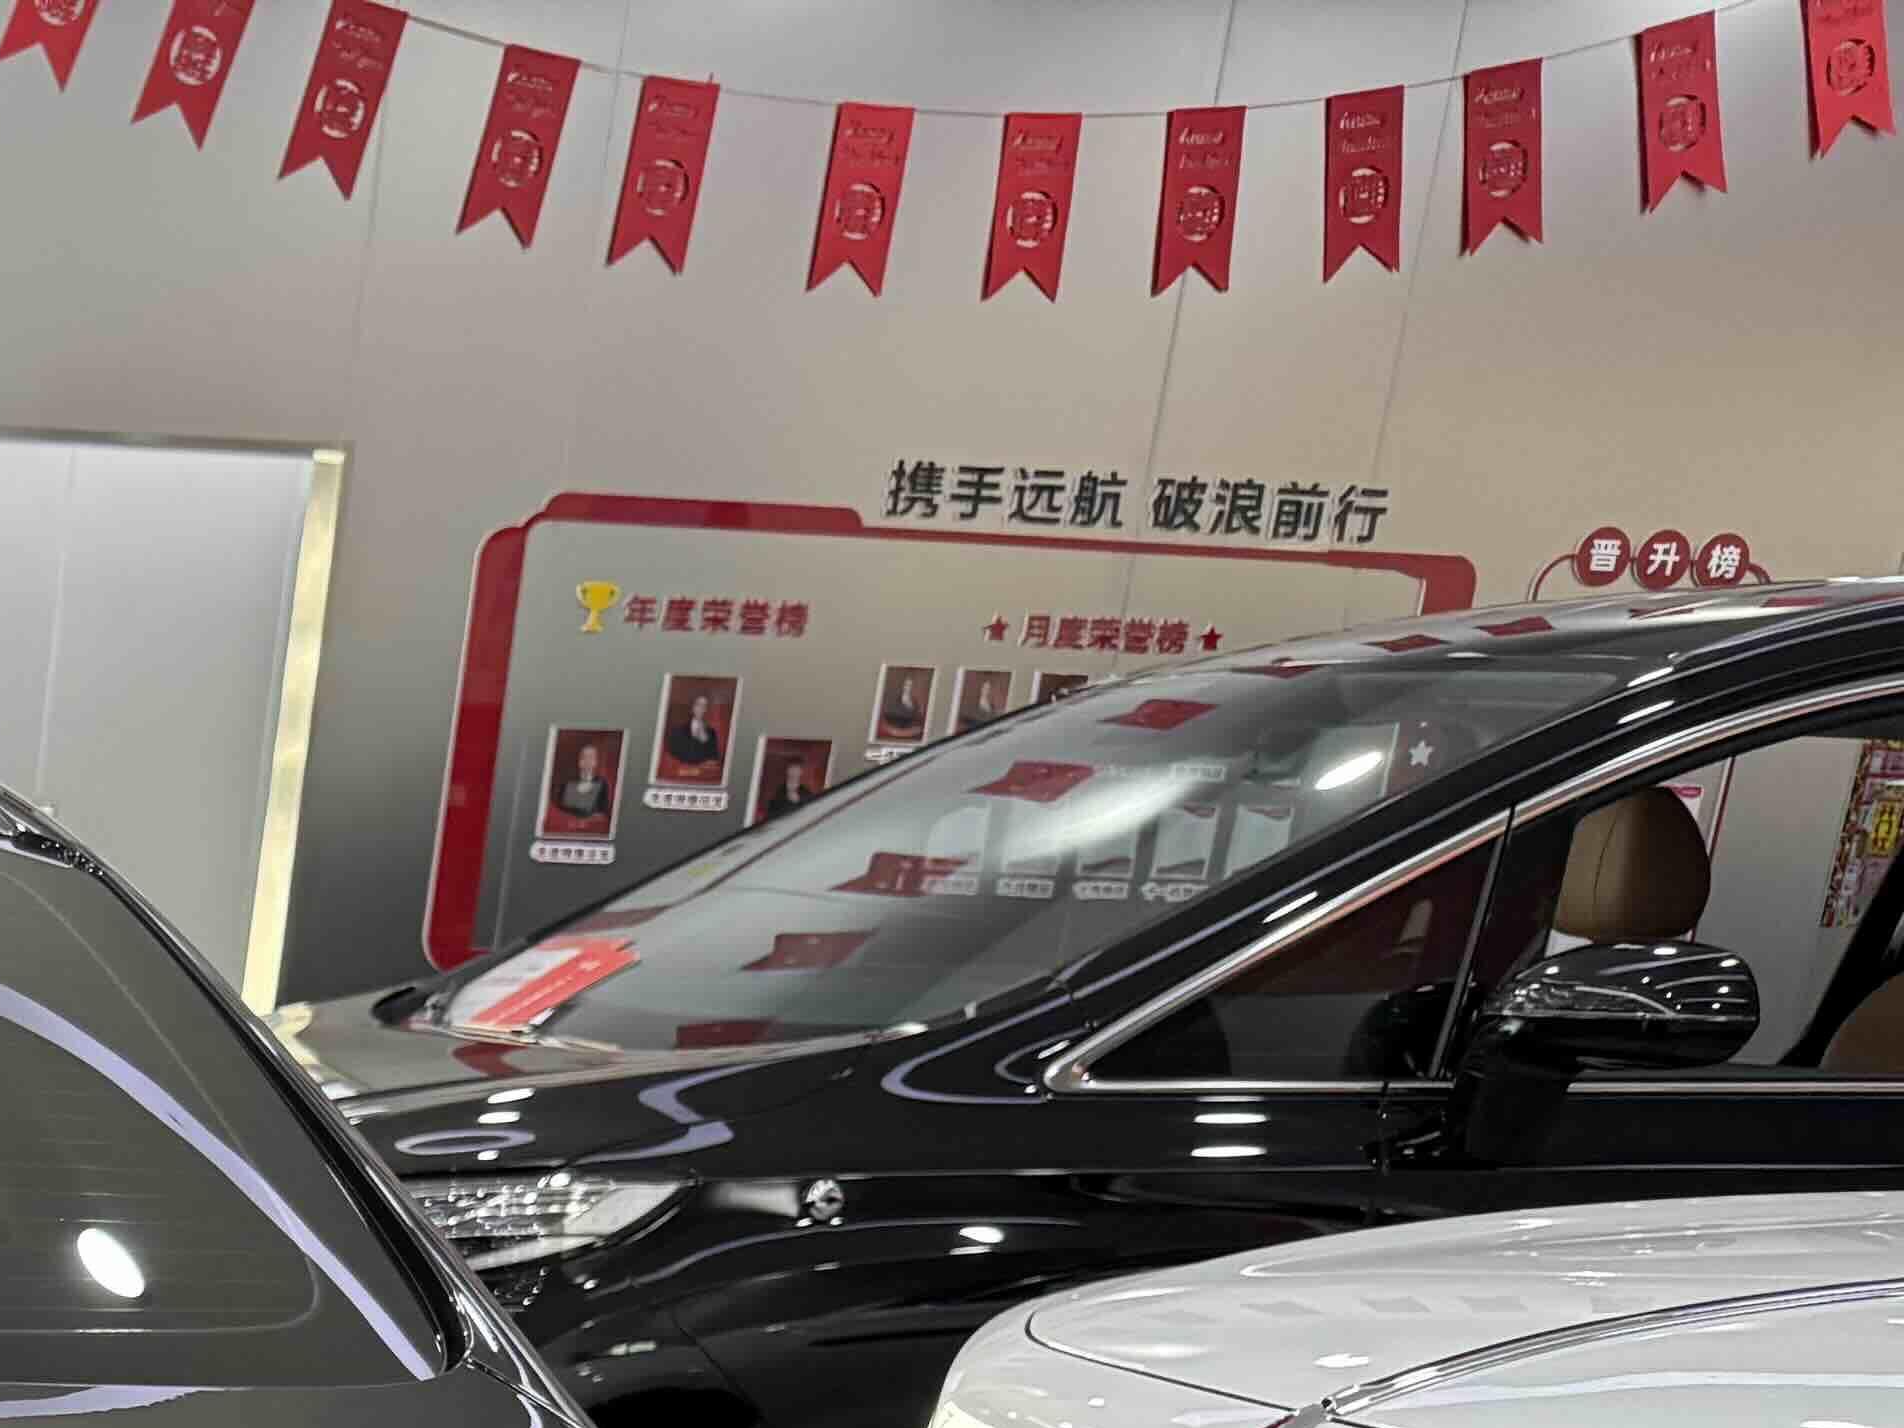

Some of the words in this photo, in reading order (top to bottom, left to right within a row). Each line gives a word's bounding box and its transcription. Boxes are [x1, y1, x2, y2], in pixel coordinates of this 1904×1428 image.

[884, 458, 1128, 530] 携手远航
[1151, 475, 1389, 544] 破浪前行
[1590, 538, 1741, 579] 晋升榜
[622, 595, 810, 640] 年度荣誉榜
[1019, 614, 1190, 655] 月度荣誉榜
